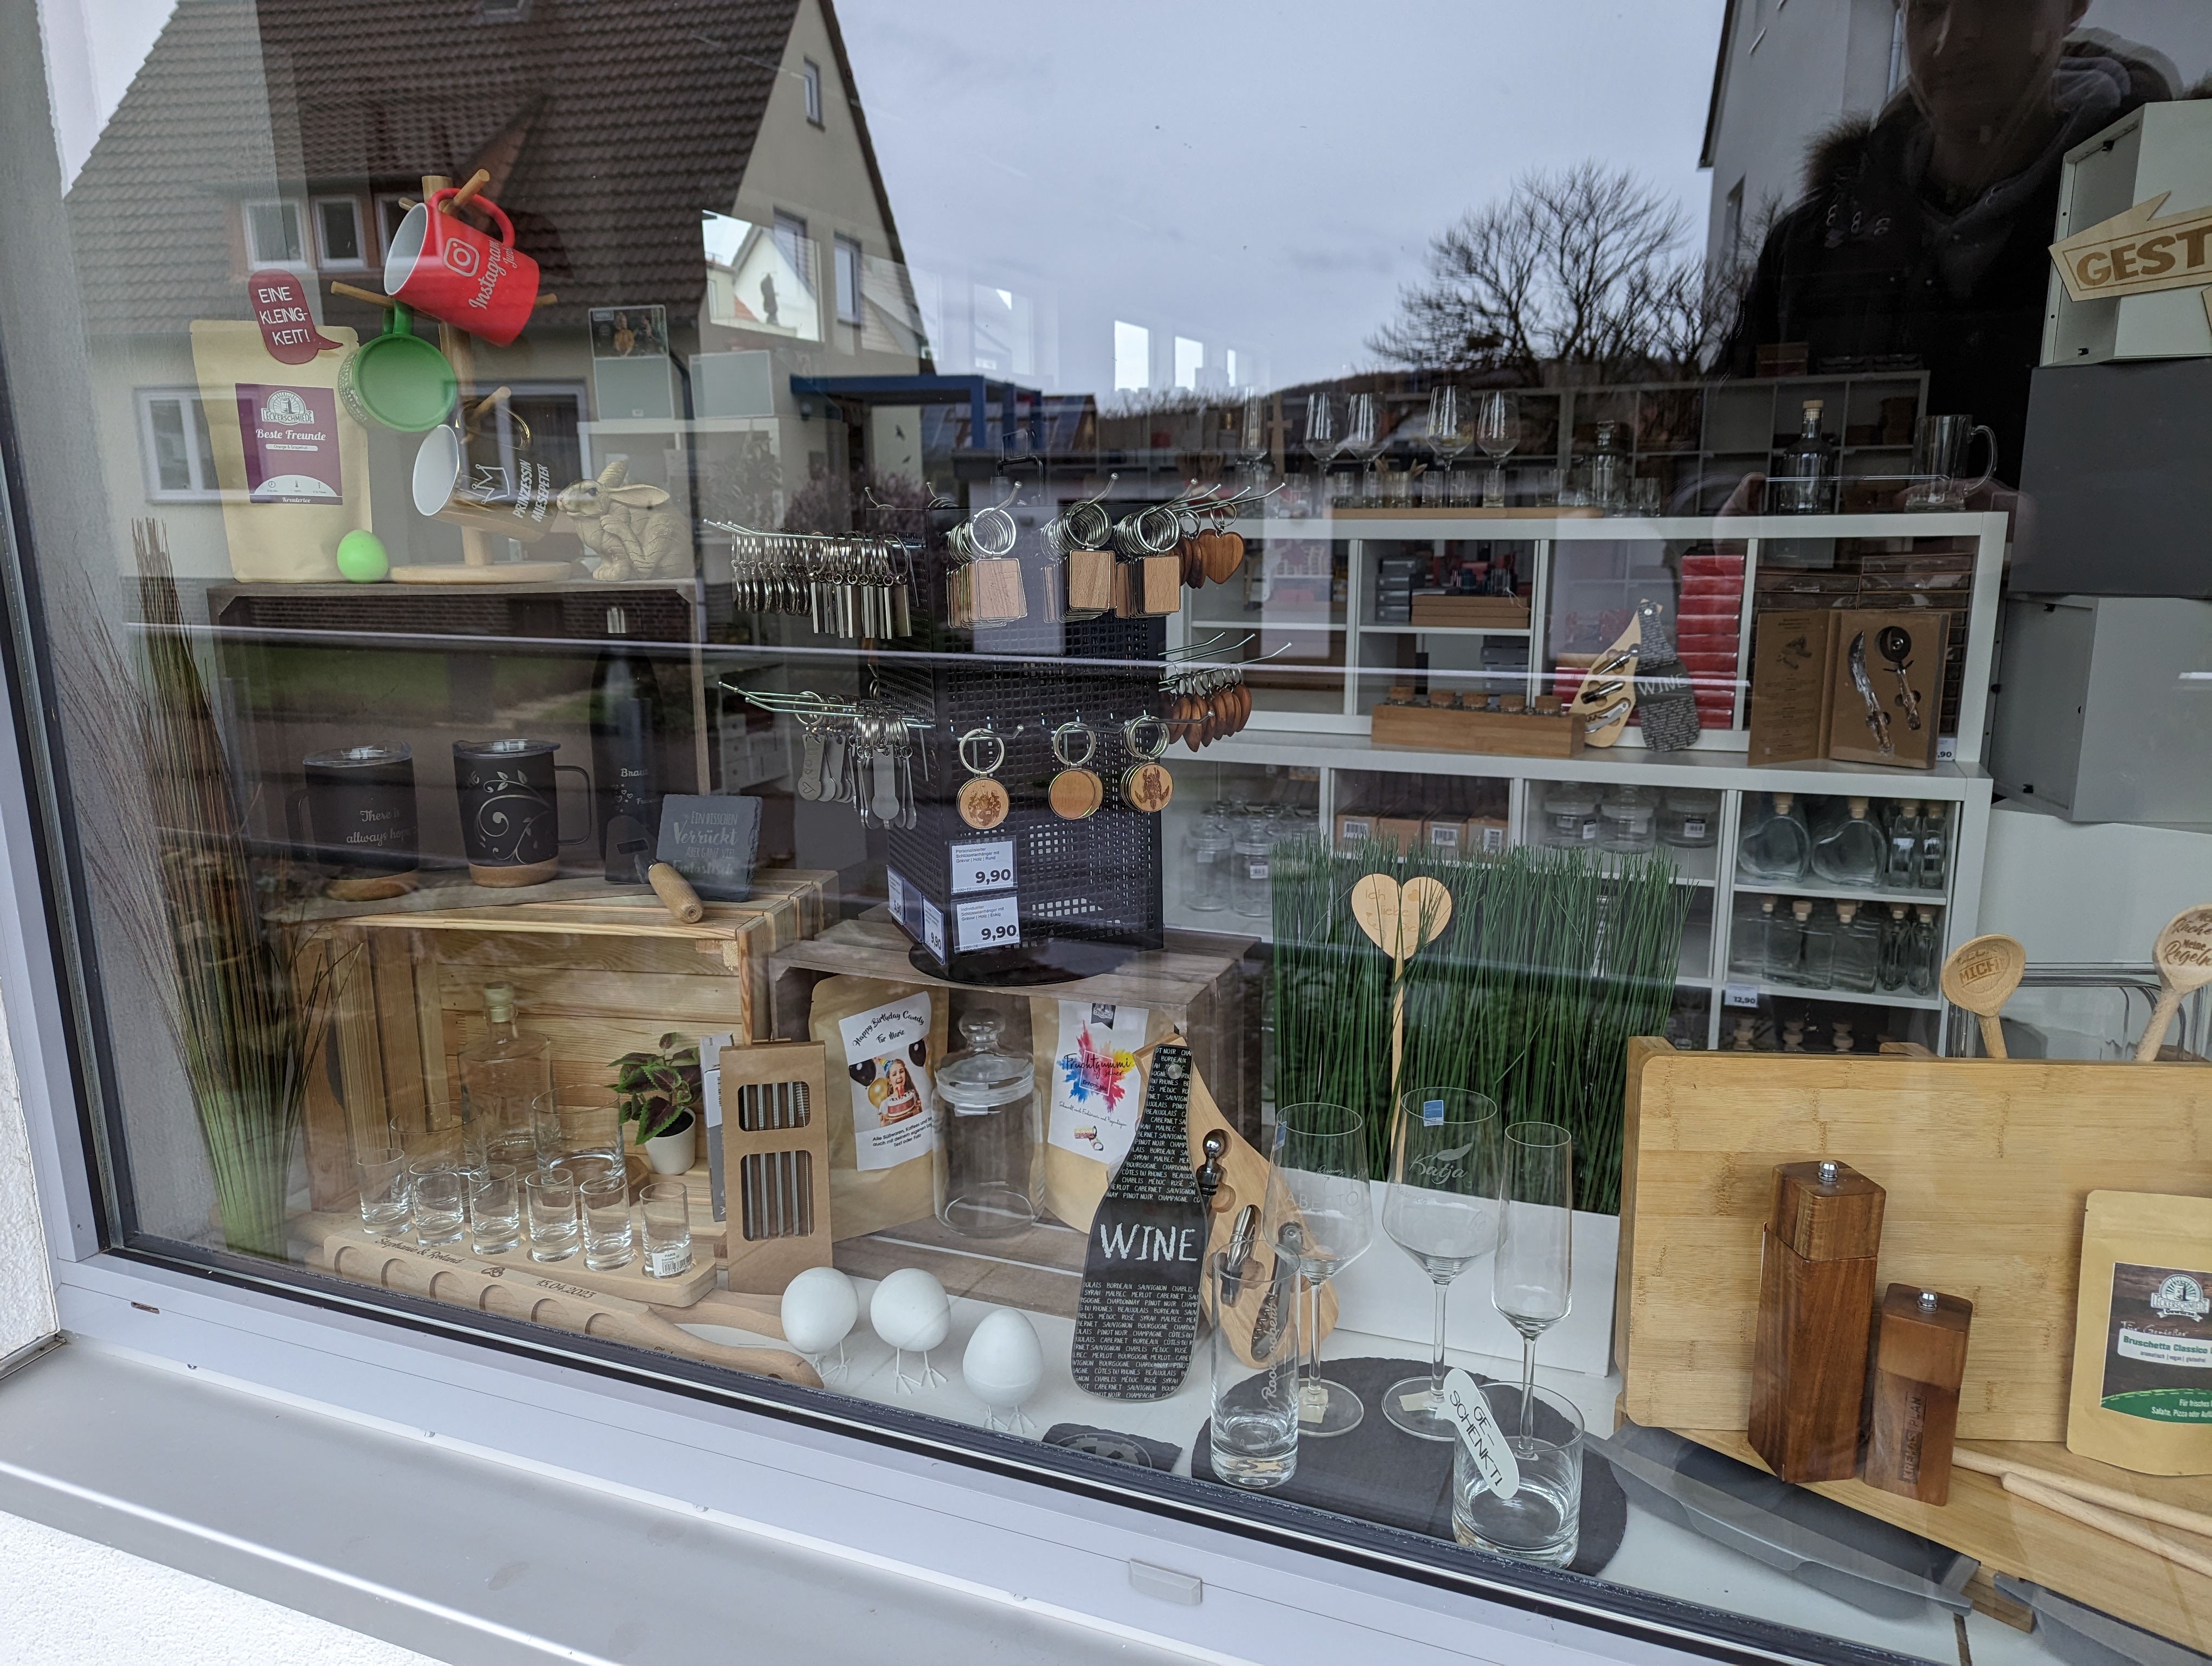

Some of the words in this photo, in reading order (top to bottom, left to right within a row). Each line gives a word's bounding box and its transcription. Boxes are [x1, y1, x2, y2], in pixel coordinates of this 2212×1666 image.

[2076, 224, 2212, 286] GEST
[468, 240, 506, 310] Instagram
[258, 286, 292, 303] EINE
[259, 307, 308, 324] KLEINIG-
[272, 329, 310, 345] KEIT!
[263, 409, 313, 422] LECKERSCHMIEDE
[255, 428, 282, 439] Beste
[285, 430, 326, 441] Freunde
[512, 458, 532, 518] PRINZESSIN
[531, 463, 550, 523] MIESEPETER
[1637, 673, 1687, 696] WINE
[360, 810, 392, 822] There
[394, 808, 401, 818] is
[691, 811, 704, 824] EIN
[346, 831, 388, 847] allways
[673, 819, 738, 845] Verrückt
[975, 869, 1011, 885] 9,90
[1366, 889, 1386, 900] Ich
[1380, 905, 1410, 917] liebe
[931, 932, 942, 951] 9,90
[981, 925, 1017, 941] 9,90
[1734, 996, 1756, 1004] 12,90
[852, 1024, 873, 1047] Happy
[871, 1012, 901, 1028] Birthday
[902, 1010, 924, 1026] Candy
[876, 1033, 886, 1043] Für
[889, 1029, 905, 1040] Marie
[1064, 1053, 1132, 1080] Fruchtgummi
[883, 1129, 905, 1139] Süßwaren,
[894, 1132, 910, 1142] deinem
[911, 1125, 926, 1136] eigenen
[1409, 1154, 1468, 1184] Katja
[1158, 1194, 1188, 1202] CHAMPAGNE
[1099, 1221, 1198, 1263] WINE
[375, 1238, 418, 1253] Stephanie
[427, 1251, 466, 1264] Roland
[536, 1279, 596, 1298] 15.04.2023
[1117, 1306, 1149, 1314] BEAUJOLAIS
[2121, 1321, 2140, 1331] Für
[2124, 1335, 2170, 1350] Bruschetta
[2173, 1344, 2207, 1354] Classico
[1909, 1396, 1921, 1428] PLAN
[1474, 1405, 1494, 1446] GE-
[1450, 1390, 1503, 1486] SCHENKT!
